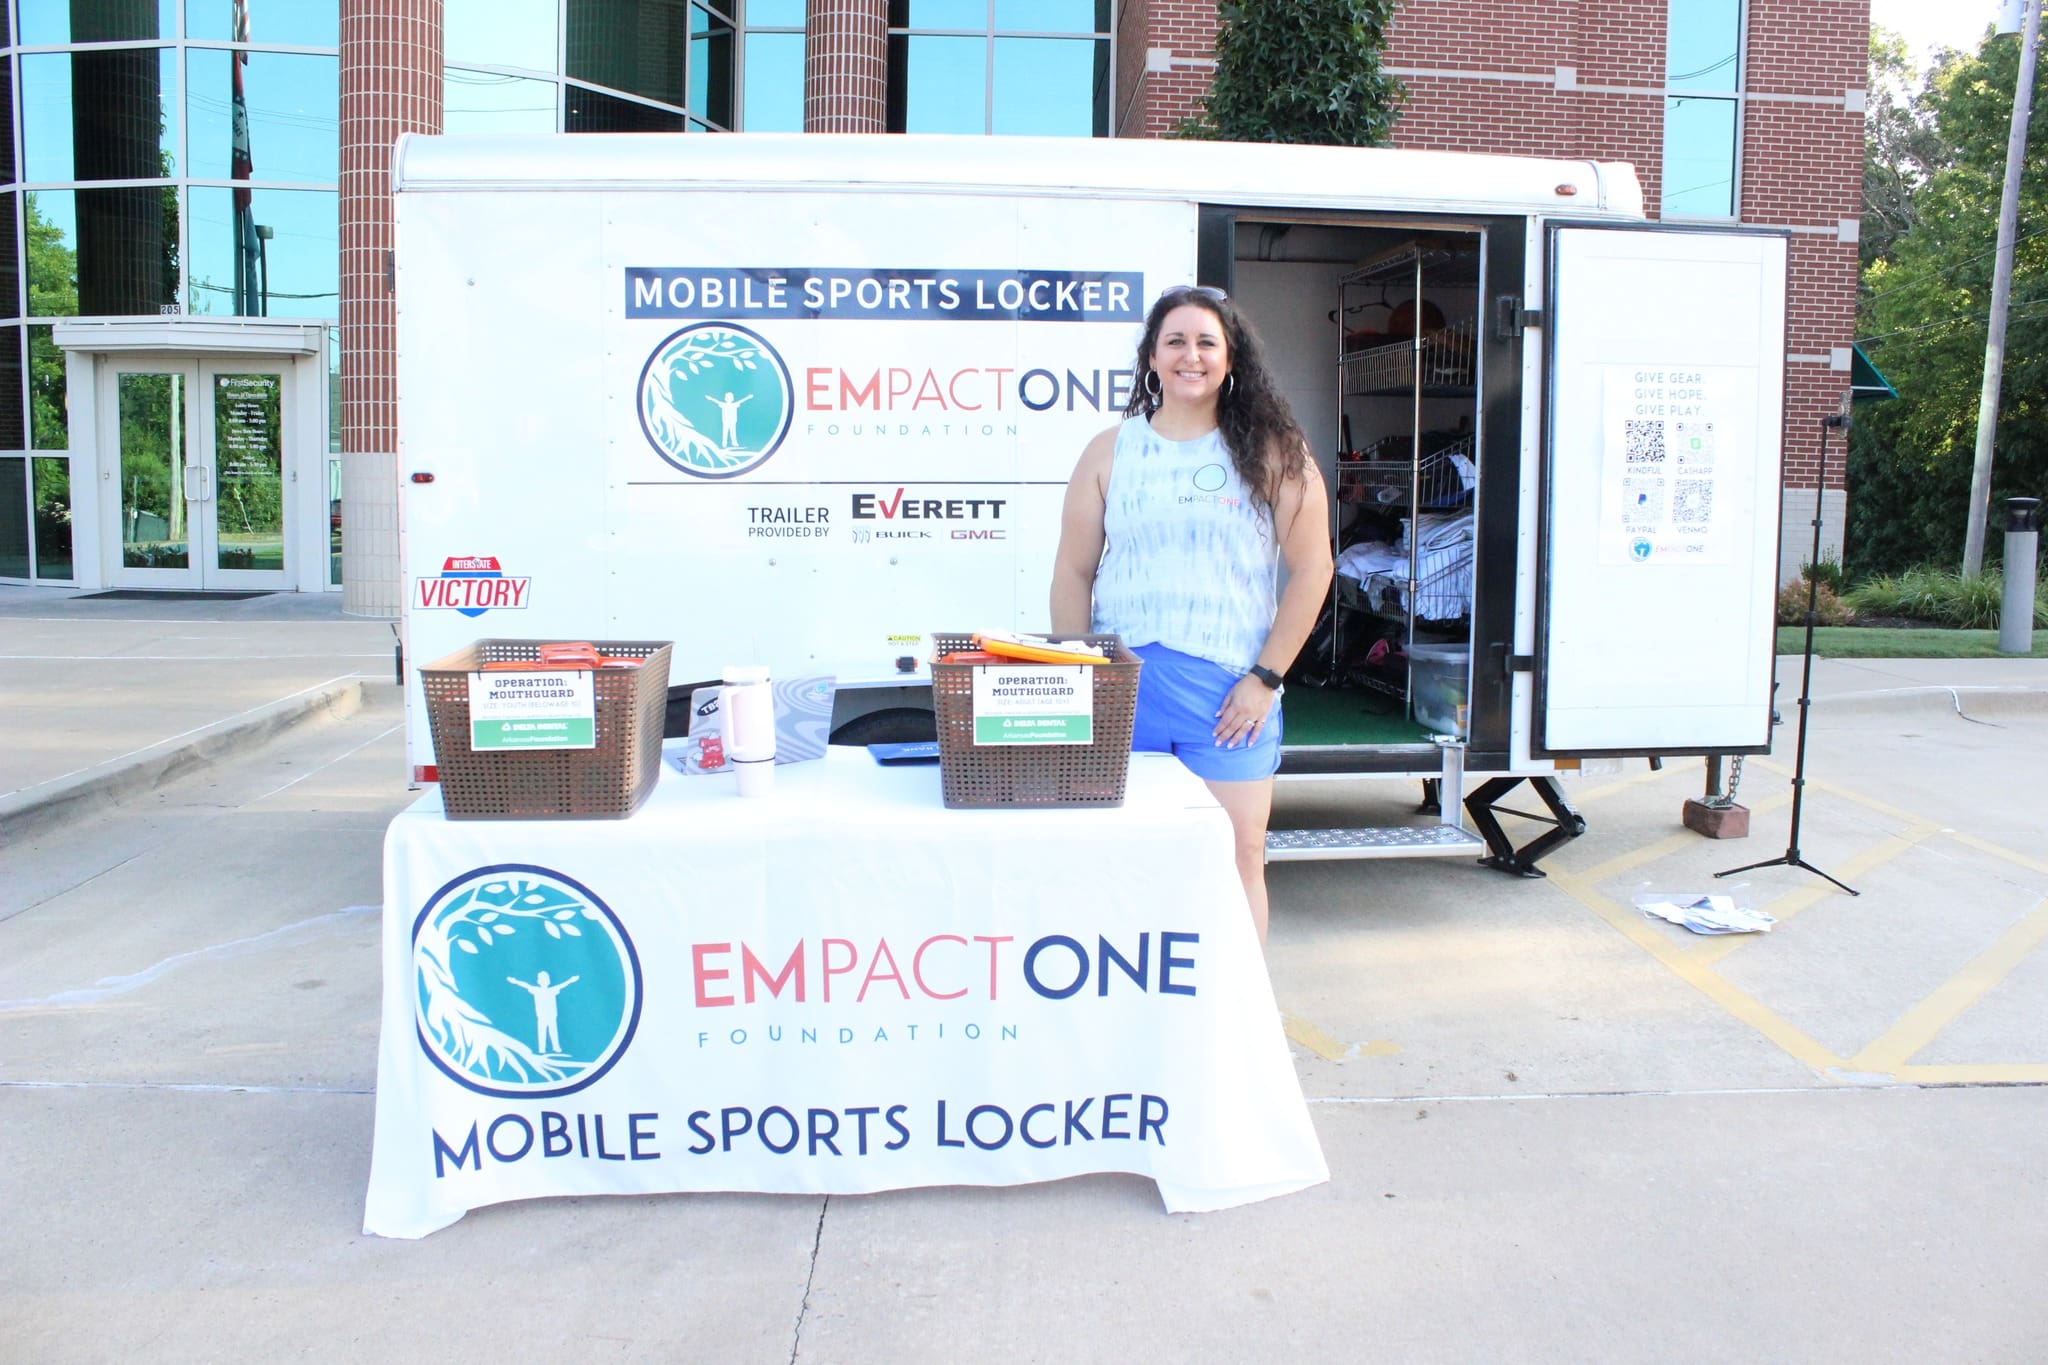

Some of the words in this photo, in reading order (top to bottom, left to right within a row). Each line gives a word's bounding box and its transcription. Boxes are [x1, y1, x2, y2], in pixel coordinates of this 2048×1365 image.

[634, 277, 787, 308] MOBILE
[803, 278, 960, 311] SPORTS
[976, 280, 1130, 312] LOCKER
[161, 306, 178, 314] 205
[230, 378, 275, 388] FirstSecurity
[1634, 372, 1664, 383] GIVE
[807, 368, 1132, 412] EMPACTONE
[1634, 388, 1663, 399] GIVE
[1635, 405, 1664, 415] GIVE
[807, 424, 1017, 436] FOUNDATION
[852, 488, 1006, 519] EVERETT
[1178, 495, 1241, 507] EMPACTONE
[748, 507, 829, 523] TRAILER
[748, 527, 811, 538] PROVIDED
[814, 527, 829, 537] BY
[876, 531, 932, 539] BUICK
[951, 530, 1006, 540] GMC
[1625, 526, 1656, 534] PAYPAL
[1677, 527, 1708, 535] VENMO
[421, 579, 527, 607] VICTORY
[489, 689, 574, 699] MOUTHGUARD
[992, 687, 1074, 696] MOUTHGUARD
[692, 932, 1198, 1008] EMPACTONE
[699, 1023, 1017, 1048] FOUNDATION
[432, 1110, 662, 1178] MOBILE
[687, 1103, 912, 1157] SPORTS
[936, 1093, 1168, 1149] LOCKER
